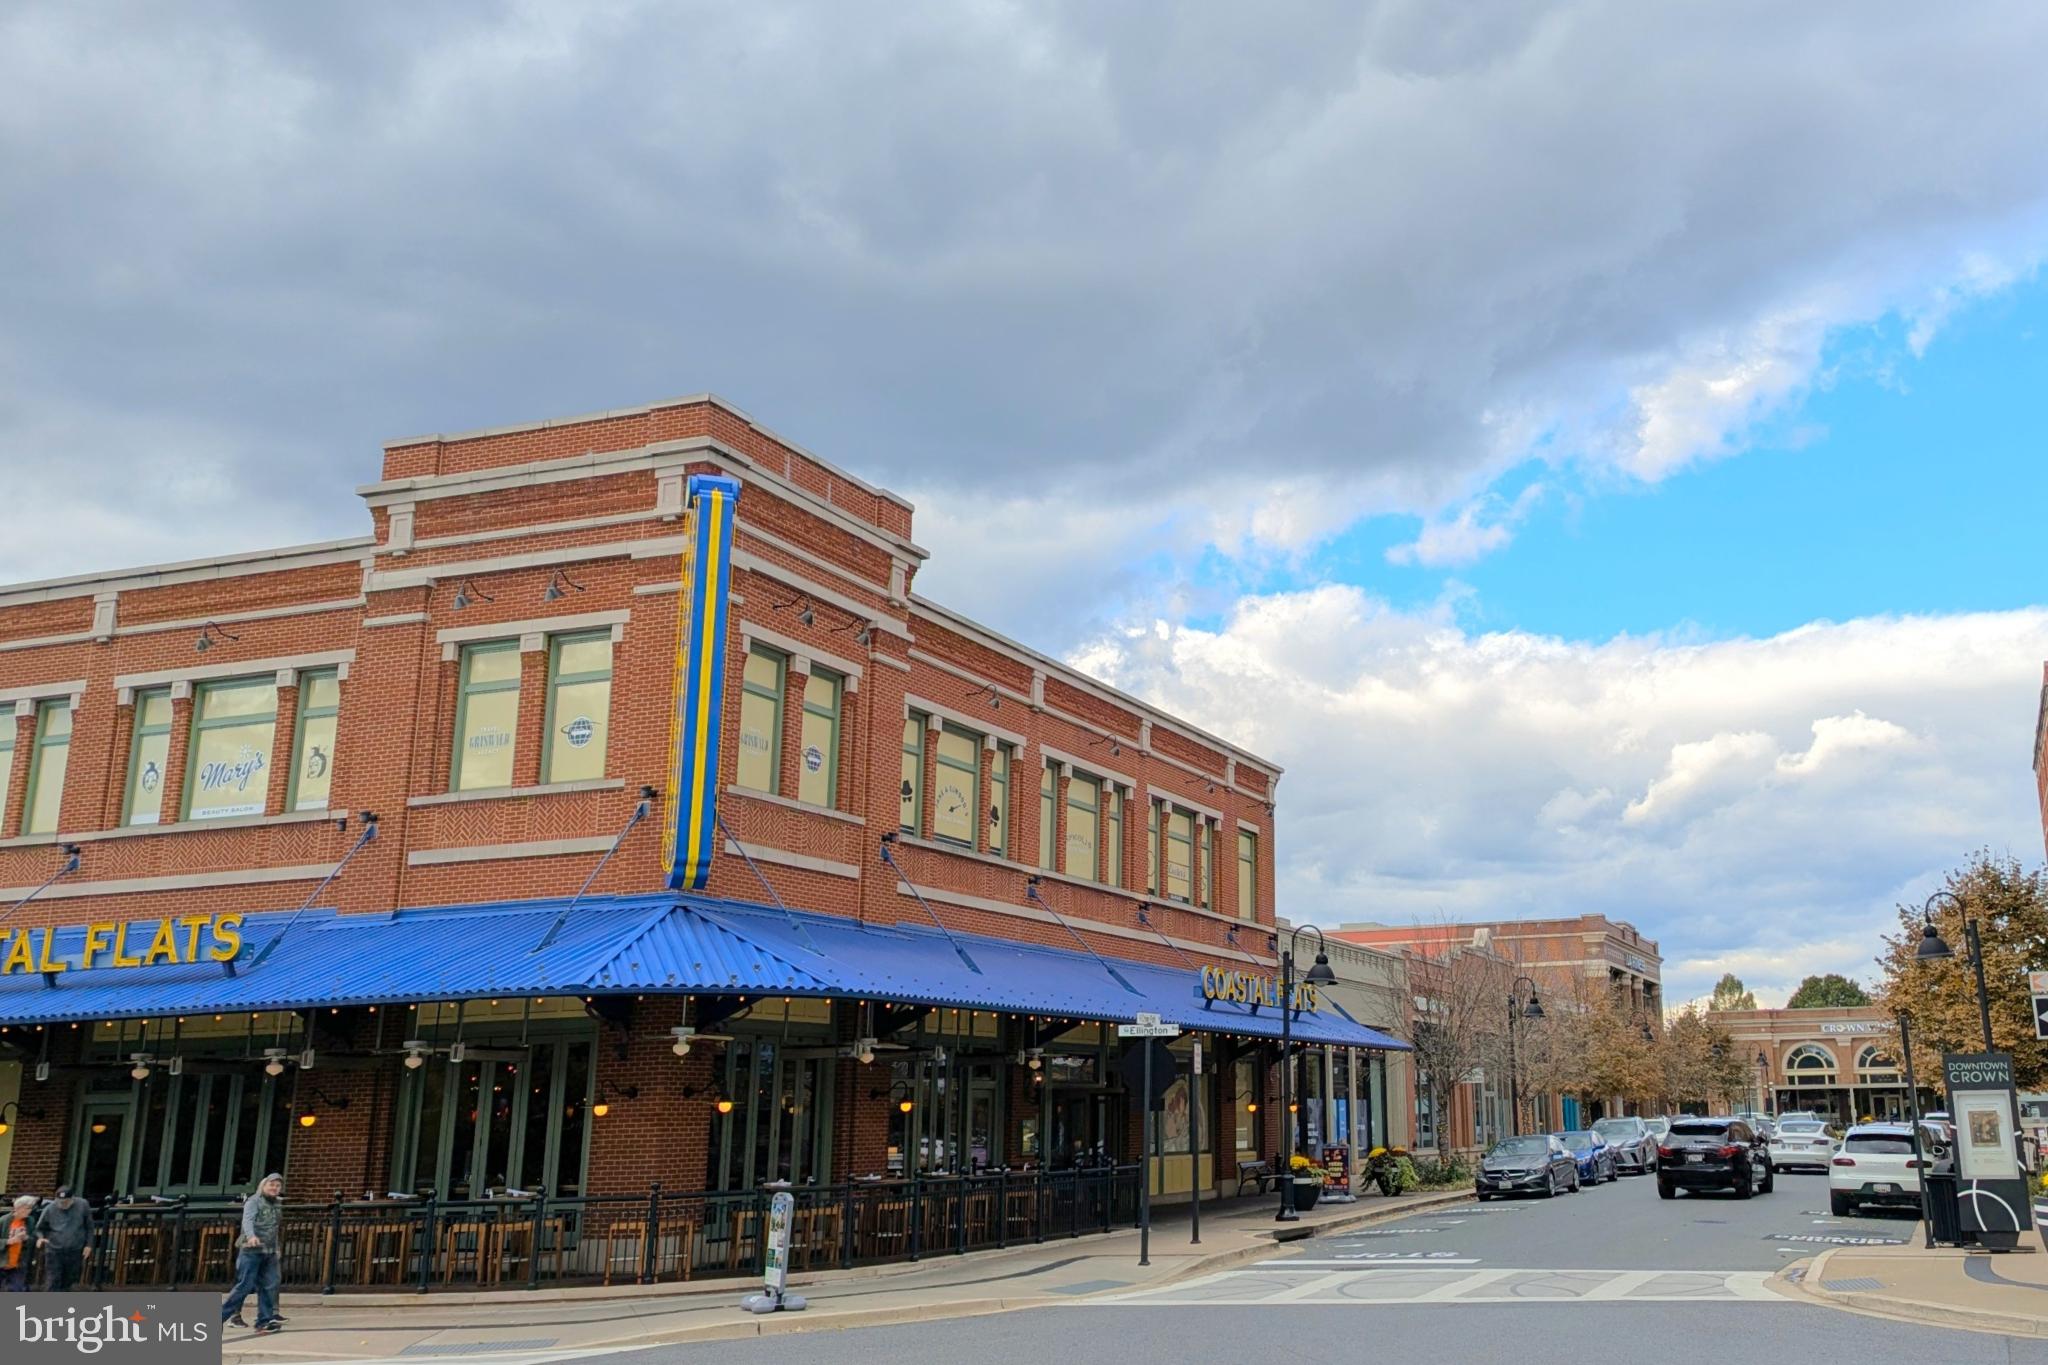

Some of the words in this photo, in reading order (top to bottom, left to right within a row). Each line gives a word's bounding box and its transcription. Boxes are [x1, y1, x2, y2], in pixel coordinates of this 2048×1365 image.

[201, 751, 264, 792] Mary's
[83, 913, 244, 969] FLATS
[1201, 965, 1274, 1007] COASTAL
[1276, 978, 1318, 1013] FATS
[1130, 1026, 1168, 1036] Ellington
[1948, 1061, 2008, 1072] DOWNTOWN
[1950, 1070, 2010, 1083] CROWN
